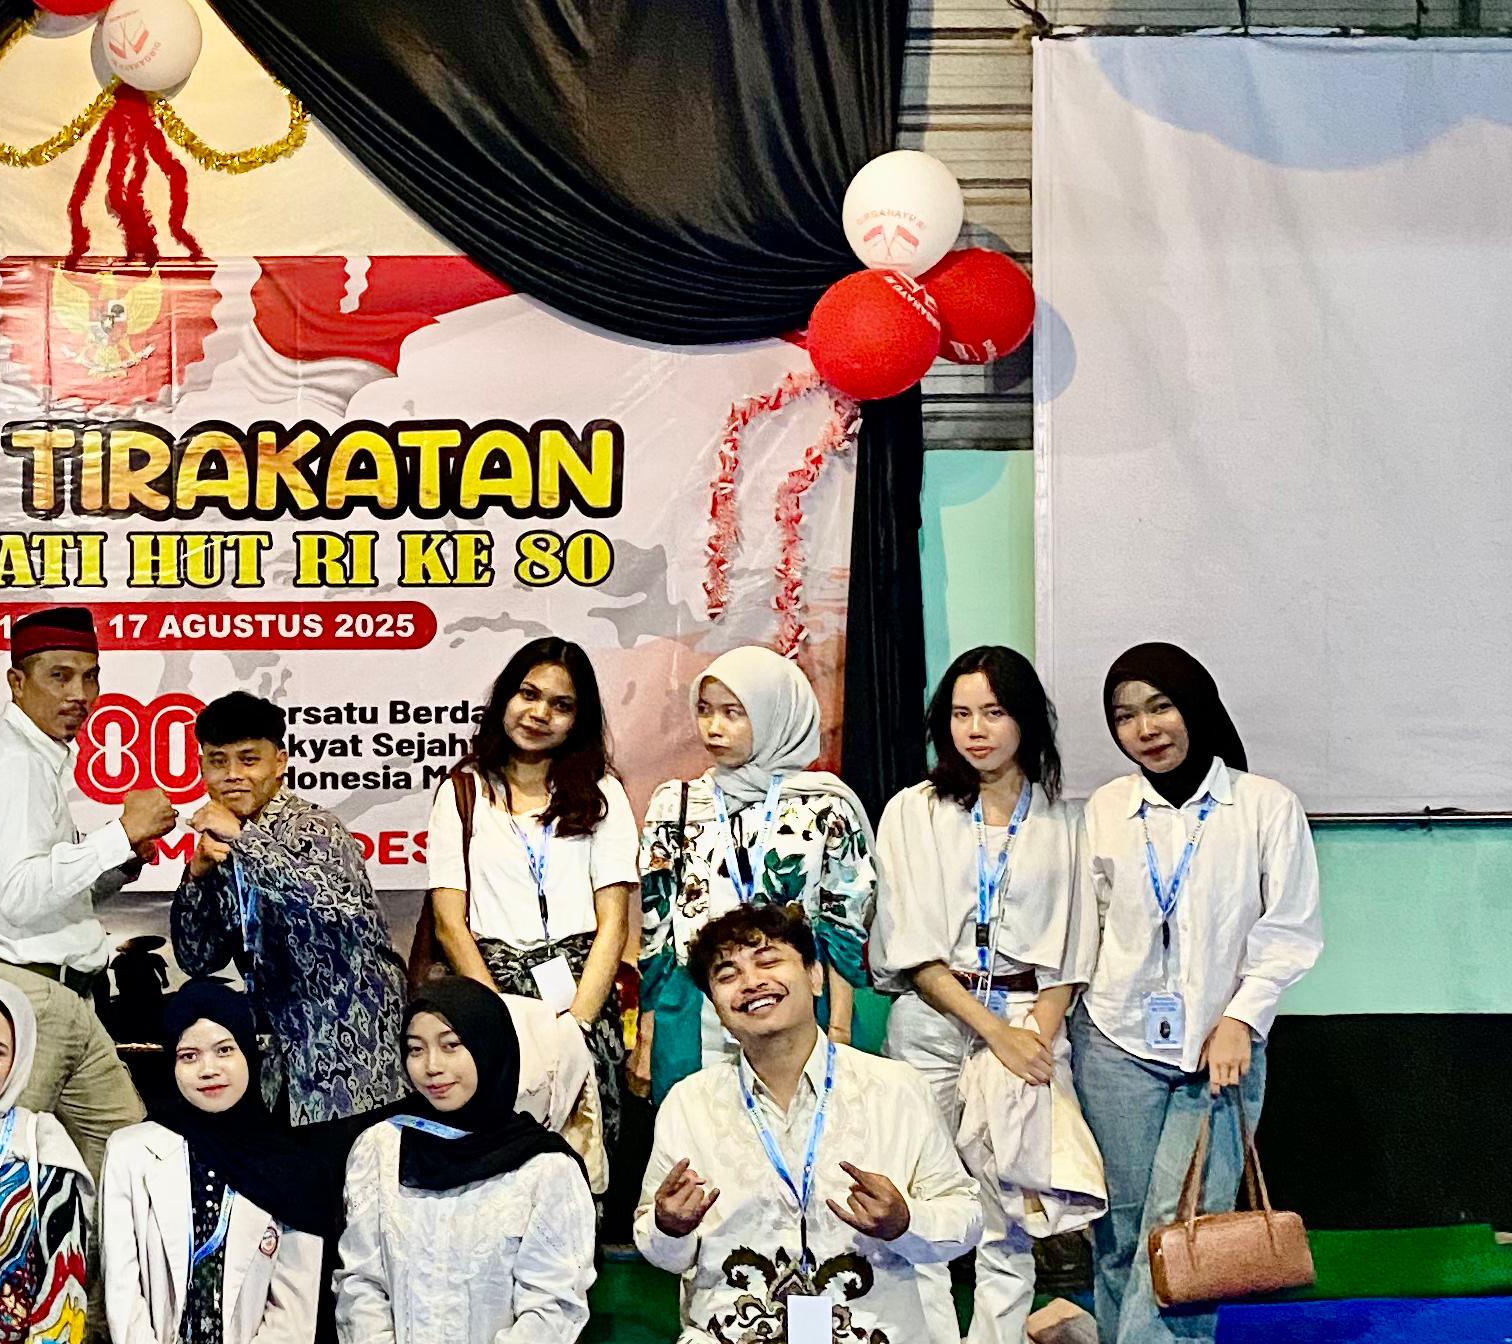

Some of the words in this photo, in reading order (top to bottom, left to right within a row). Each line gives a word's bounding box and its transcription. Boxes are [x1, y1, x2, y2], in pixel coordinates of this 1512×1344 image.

[1, 419, 624, 519] TIRAKATAN
[128, 531, 272, 588] HUT
[294, 531, 378, 588] RI
[398, 530, 495, 587] KE
[513, 530, 615, 587] 80
[108, 613, 145, 639] 17
[158, 613, 324, 639] AGUSTUS
[334, 612, 415, 638] 2025
[84, 701, 204, 797] 80
[372, 731, 473, 764] Sejah
